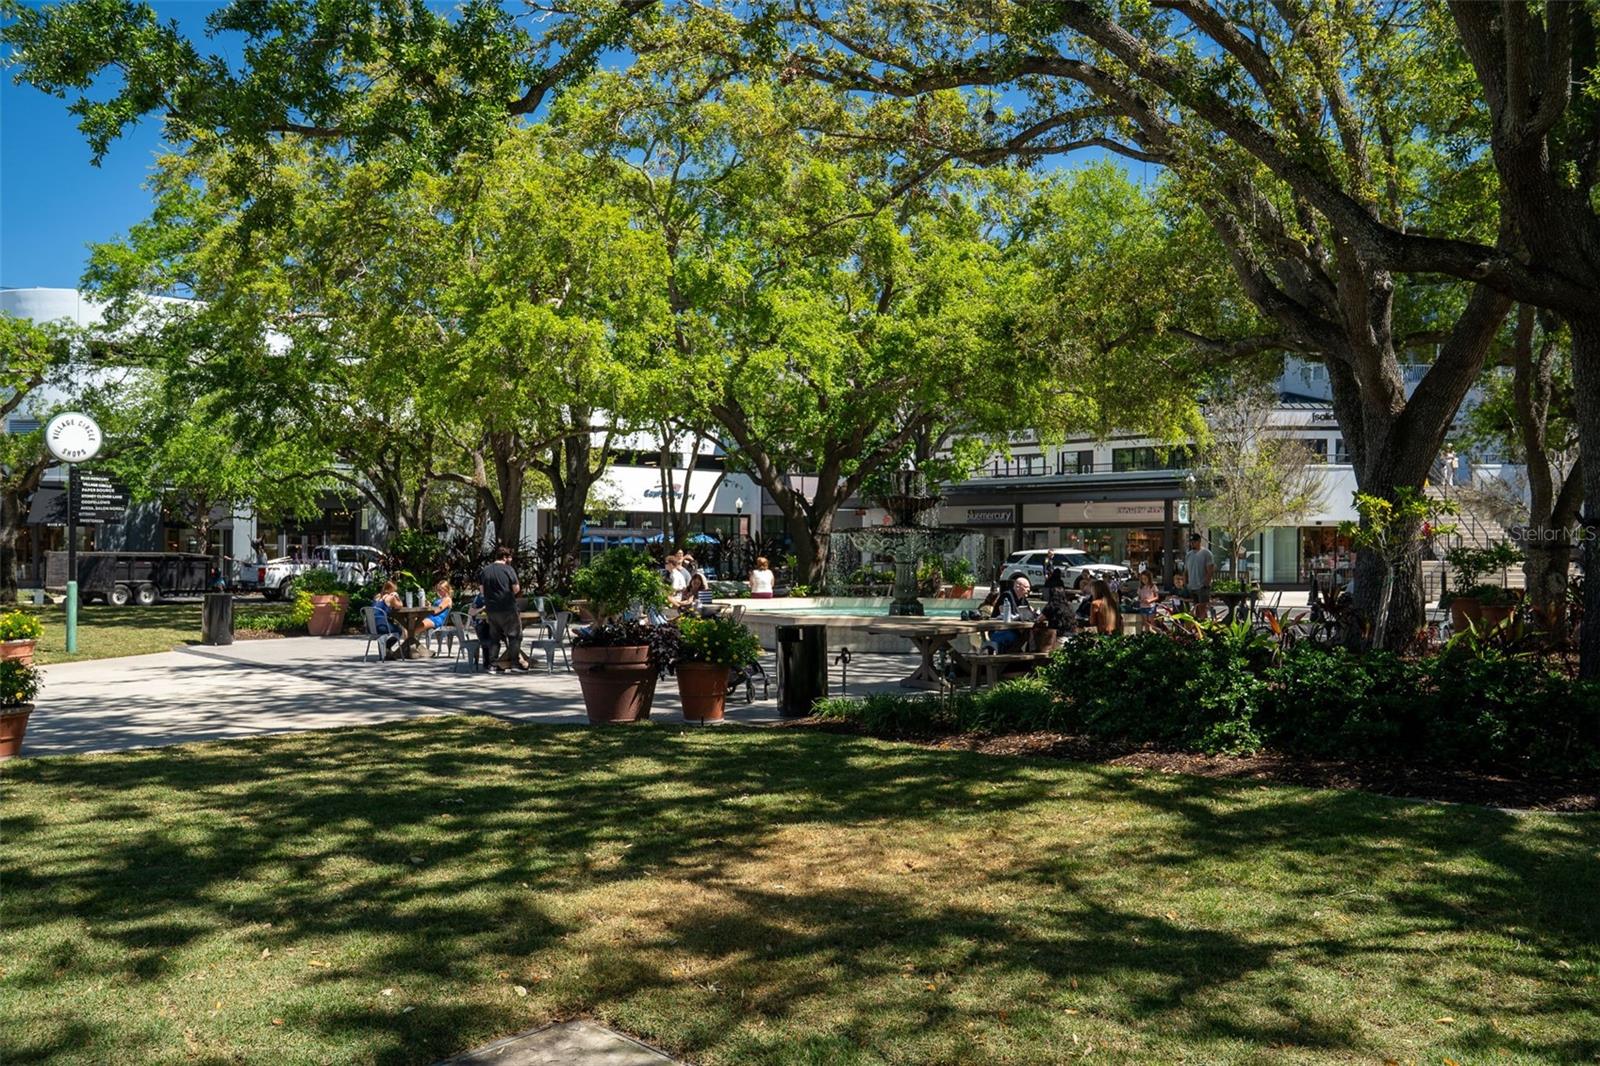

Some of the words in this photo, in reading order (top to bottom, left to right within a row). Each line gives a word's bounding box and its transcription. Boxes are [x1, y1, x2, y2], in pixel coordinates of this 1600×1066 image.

[53, 419, 75, 439] VILLAGE
[78, 420, 95, 440] CIRCLE
[62, 448, 86, 457] SHOPS
[966, 509, 1011, 521] bluemercury
